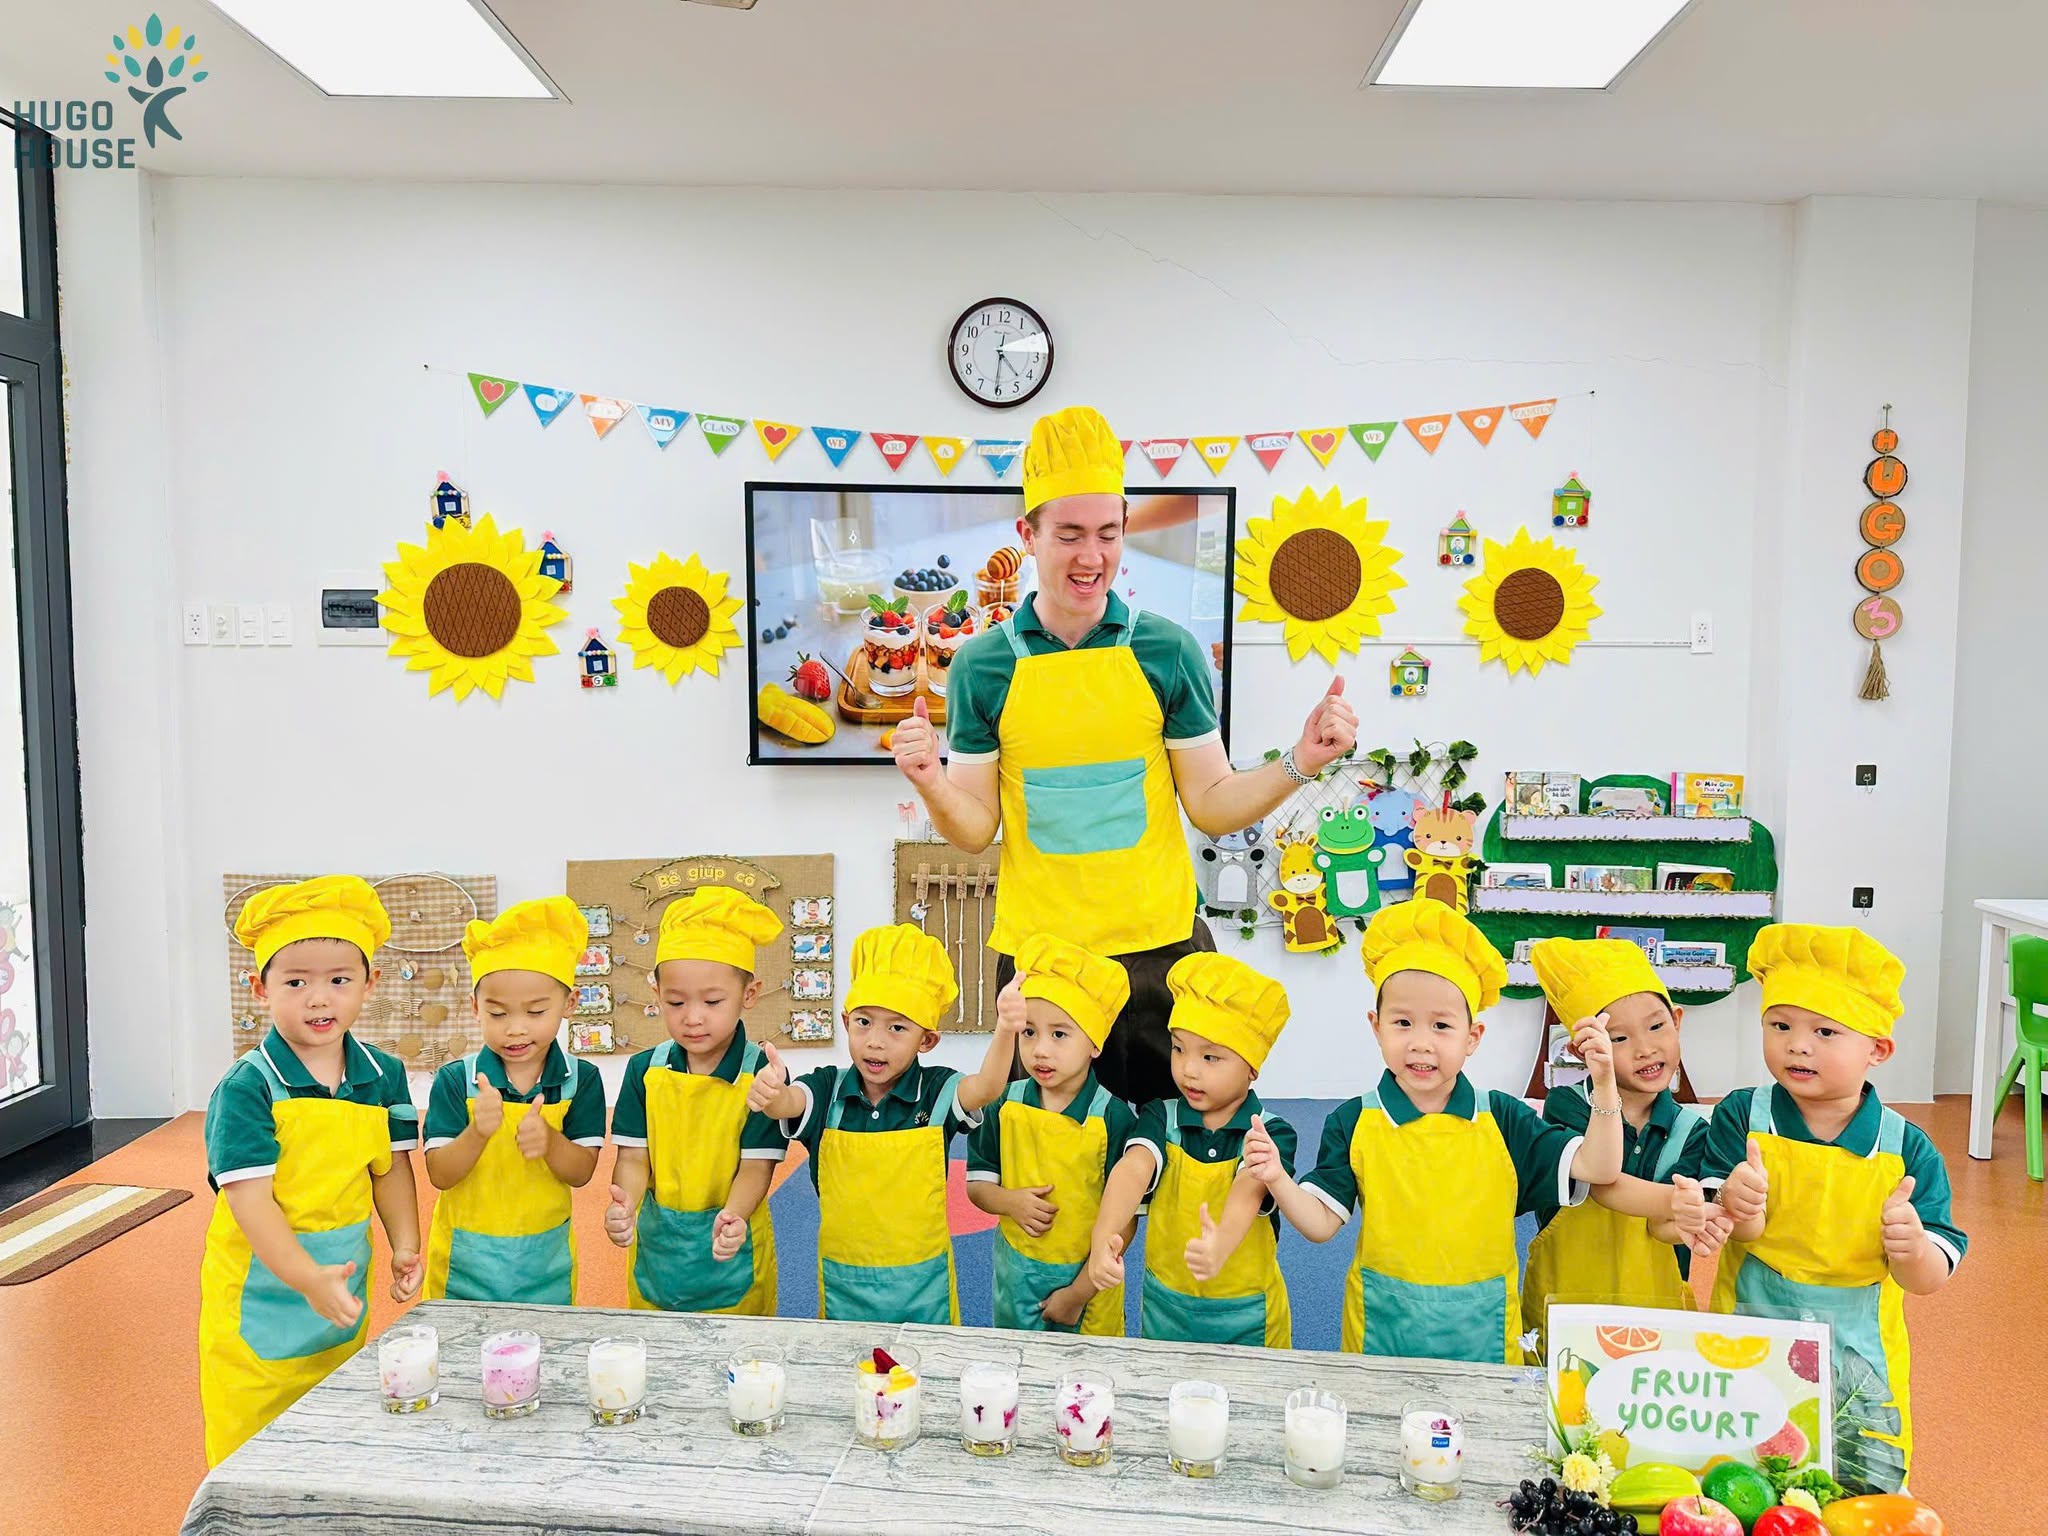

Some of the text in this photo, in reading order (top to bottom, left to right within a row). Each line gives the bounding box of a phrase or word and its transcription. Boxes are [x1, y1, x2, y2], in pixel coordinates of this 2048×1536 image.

[981, 314, 990, 326] 11
[999, 311, 1011, 323] 12
[967, 326, 979, 338] 10
[961, 344, 969, 356] 9
[1032, 352, 1040, 363] 3
[965, 363, 973, 375] 8
[1026, 369, 1033, 380] 4
[977, 378, 985, 390] 7
[1012, 382, 1020, 393] 5
[994, 385, 1002, 396] 6
[653, 417, 673, 428] MY
[703, 422, 738, 434] CLASS
[1365, 433, 1381, 442] WE
[1420, 424, 1442, 434] ARE
[1514, 405, 1554, 419] FAMILY
[828, 438, 845, 448] WE
[883, 443, 905, 453] ARE
[942, 447, 949, 456] A
[1151, 438, 1289, 456] LOVE MY CLASS
[1631, 1366, 1734, 1398] FRUIT
[1617, 1402, 1760, 1439] YOGURT
